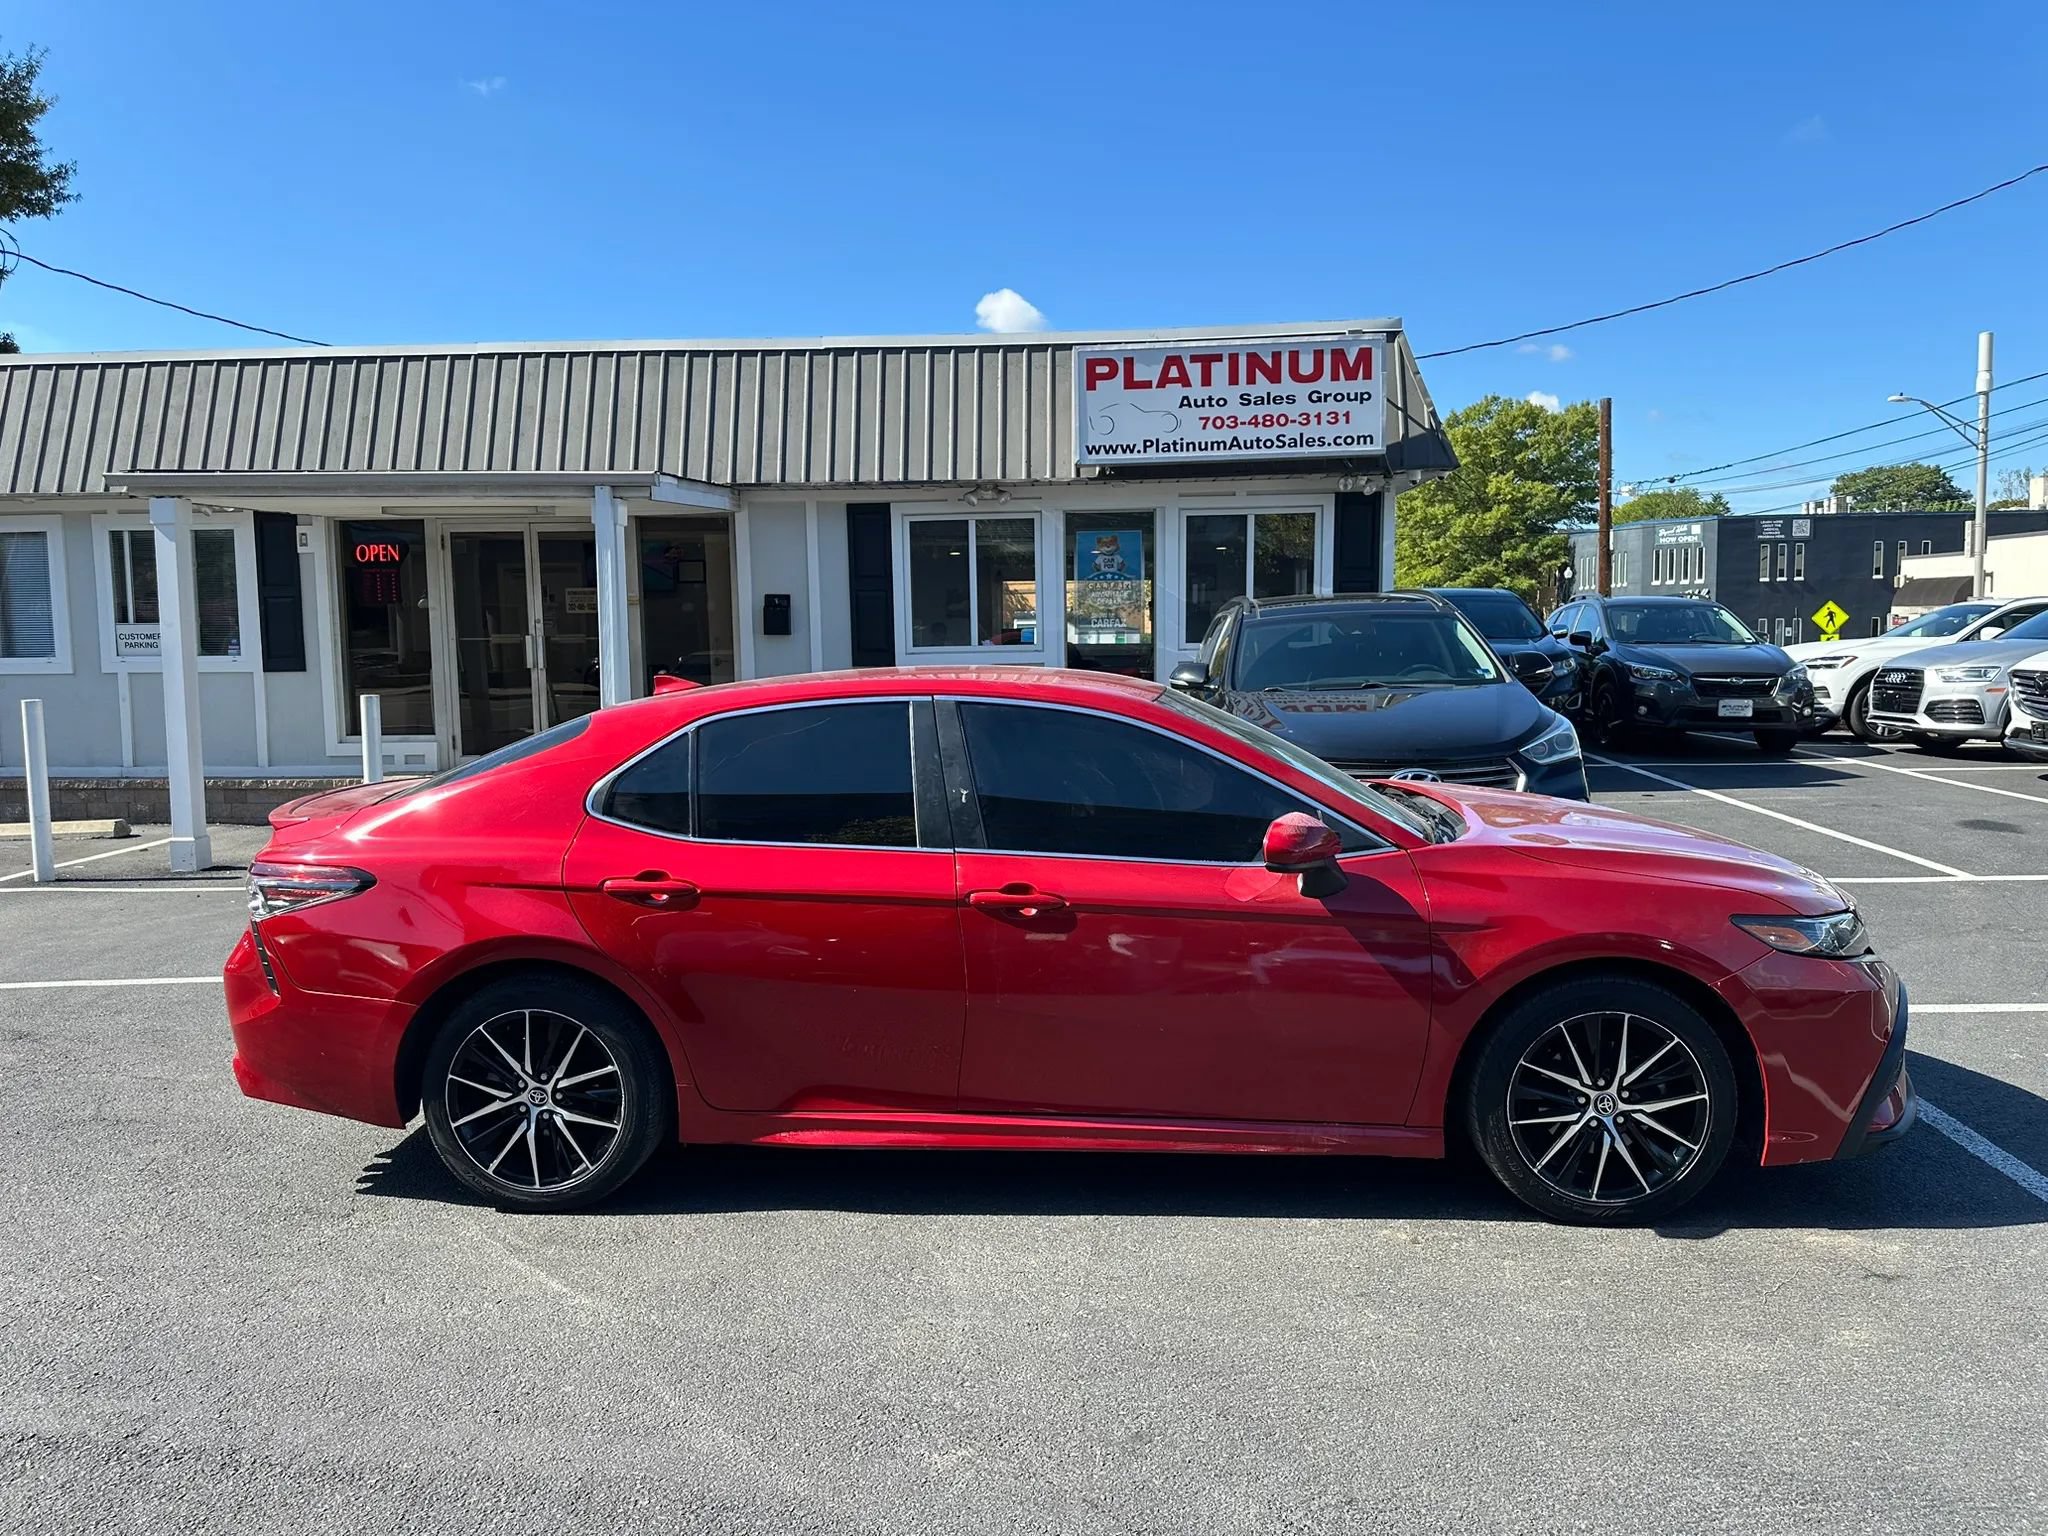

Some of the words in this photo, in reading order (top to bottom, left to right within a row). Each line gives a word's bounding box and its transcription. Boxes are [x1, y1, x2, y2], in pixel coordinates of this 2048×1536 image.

[1086, 347, 1373, 391] PLATINUM
[1178, 395, 1228, 409] Auto
[1239, 391, 1297, 407] Sales
[1307, 389, 1372, 405] Group
[1198, 410, 1352, 430] 703-480-3131
[1085, 432, 1375, 456] www.PlatinumAutoSales.com
[1660, 536, 1677, 544] NOW
[356, 544, 400, 562] OPEN
[1091, 618, 1127, 628] CARFAX
